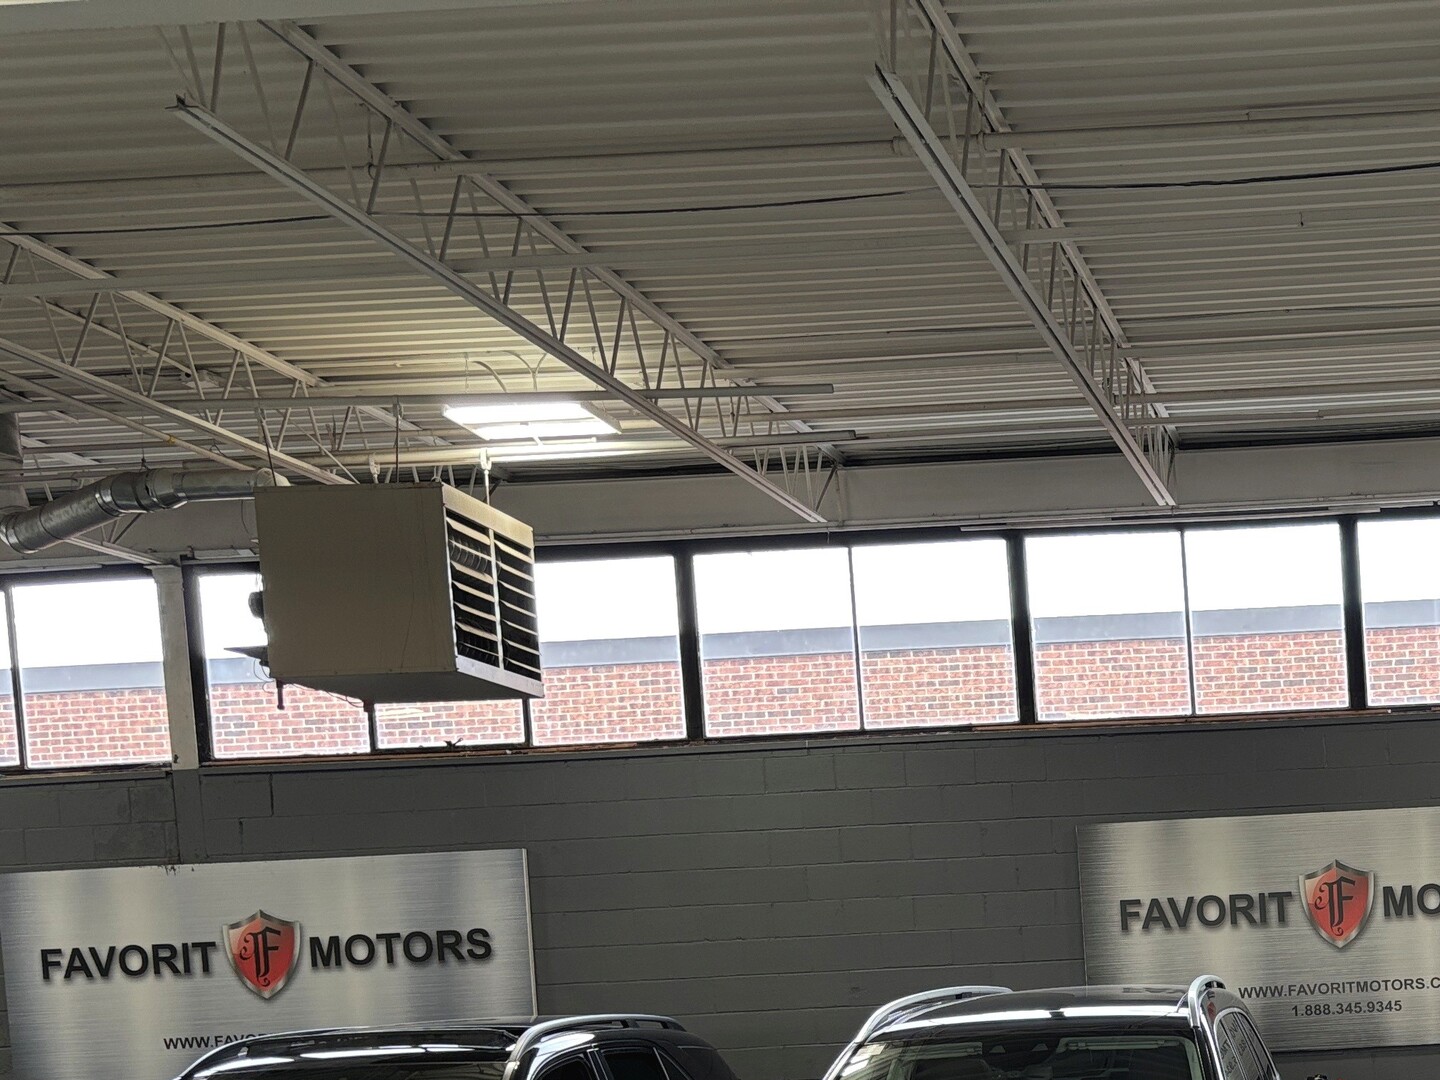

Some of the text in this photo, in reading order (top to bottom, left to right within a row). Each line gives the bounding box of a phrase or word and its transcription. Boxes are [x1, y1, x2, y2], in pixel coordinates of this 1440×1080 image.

[1119, 891, 1293, 931] FAVORIT
[40, 928, 492, 980] FAVORIT MOTORS
[1291, 1000, 1402, 1017] 1.888.345.9345
